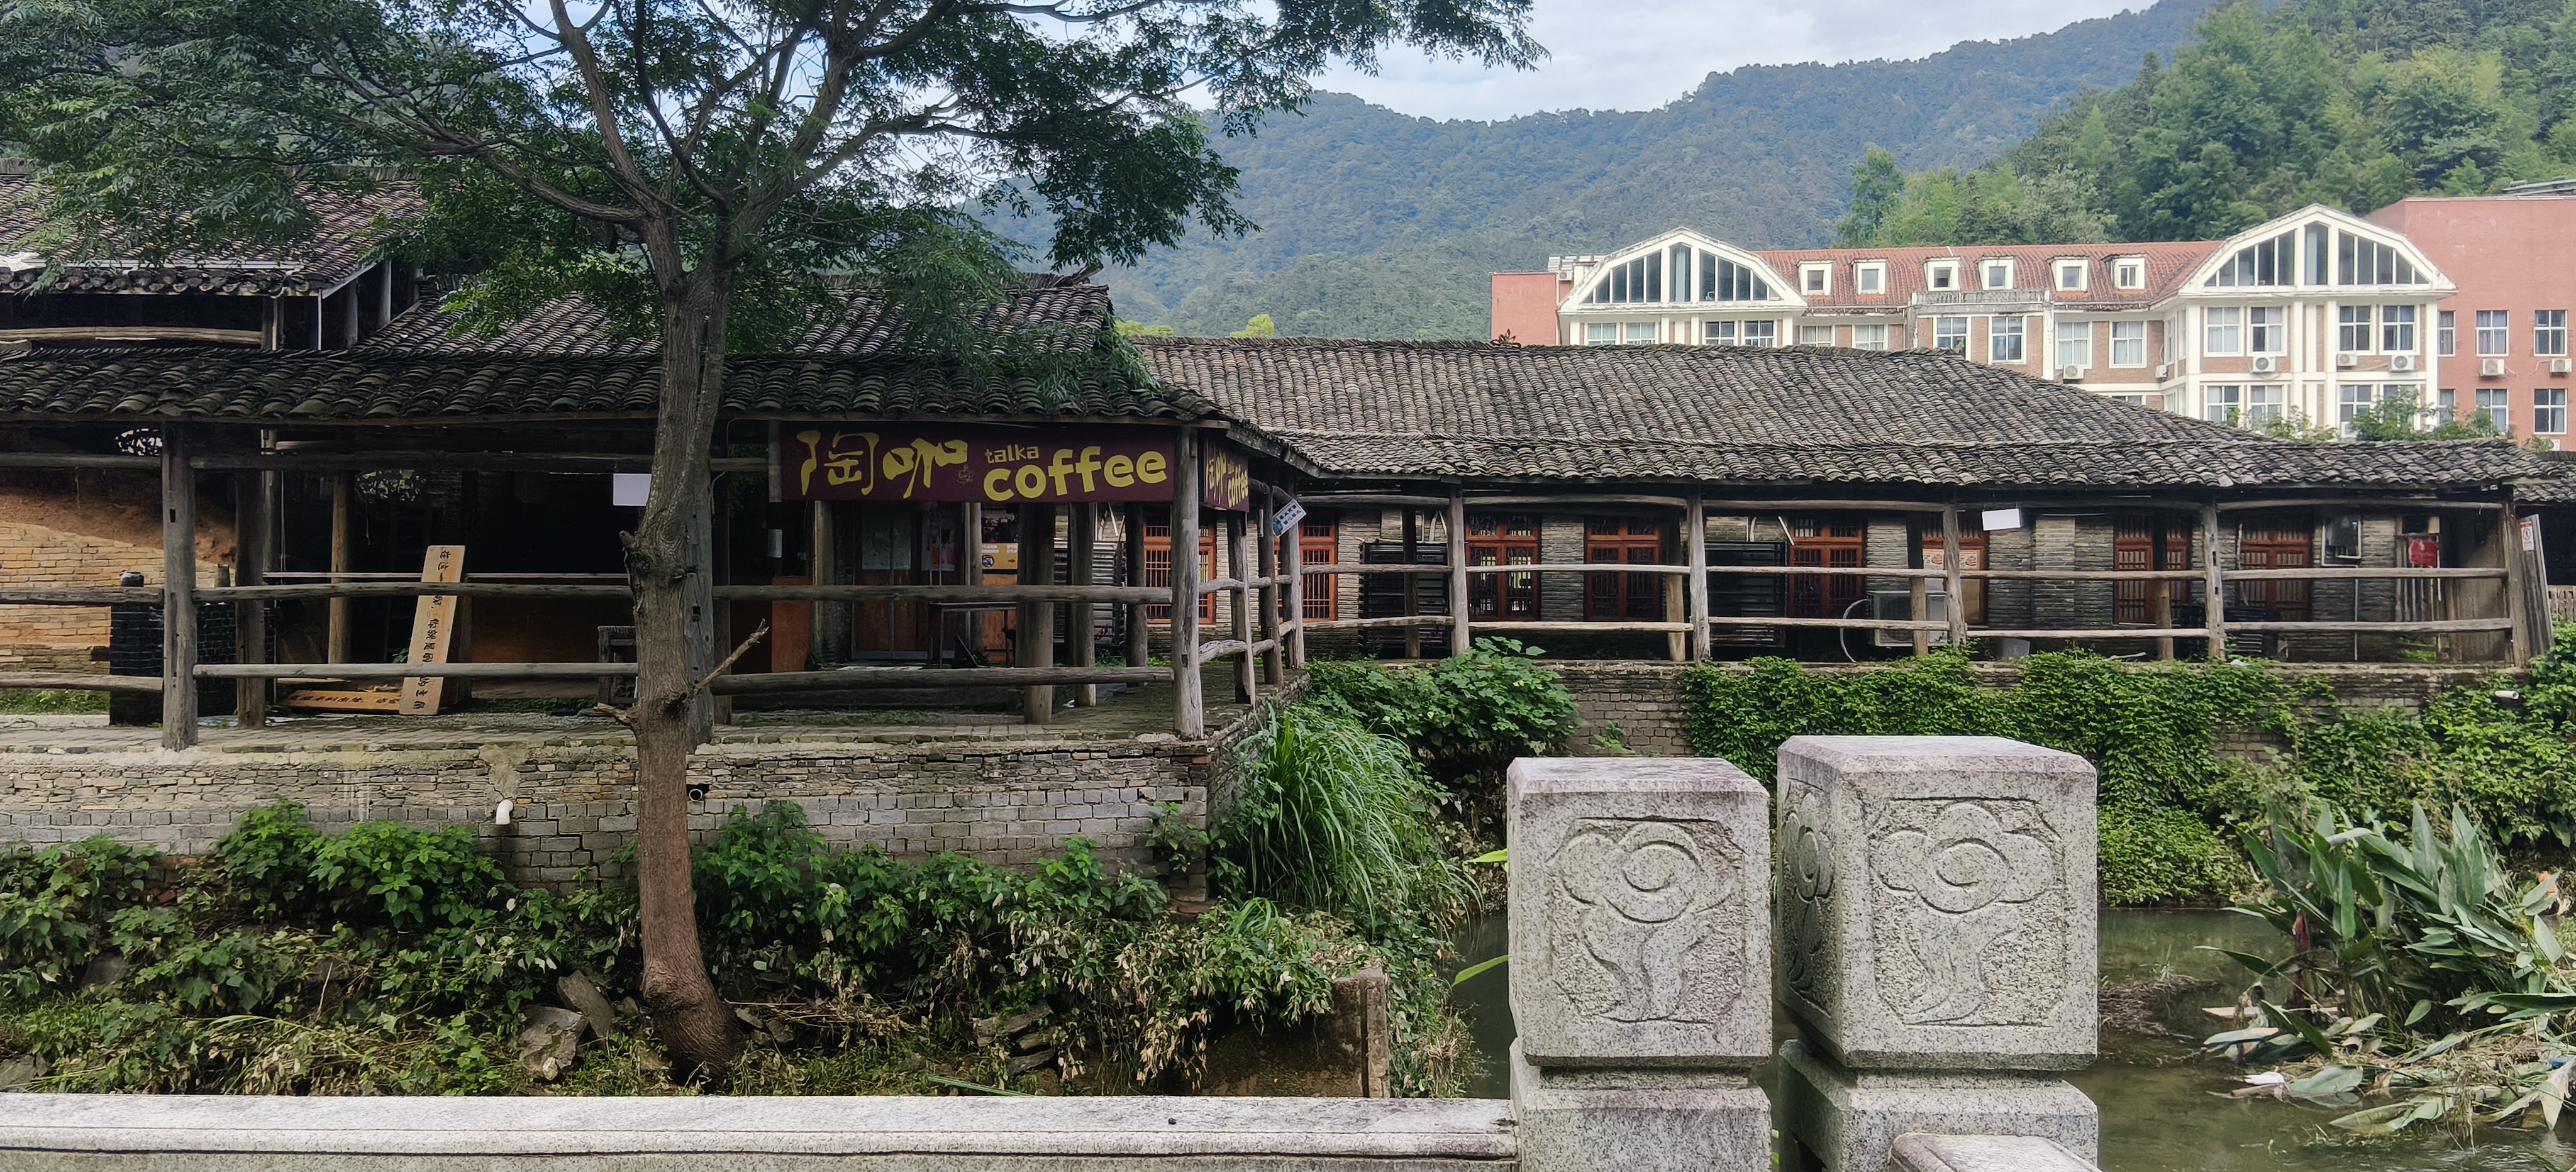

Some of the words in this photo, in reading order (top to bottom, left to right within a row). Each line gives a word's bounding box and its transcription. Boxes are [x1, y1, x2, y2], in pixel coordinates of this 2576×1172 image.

[796, 430, 968, 499] 陶咖
[983, 447, 1167, 502] coffee
[984, 444, 1040, 464] talka
[1228, 464, 1249, 508] coffee
